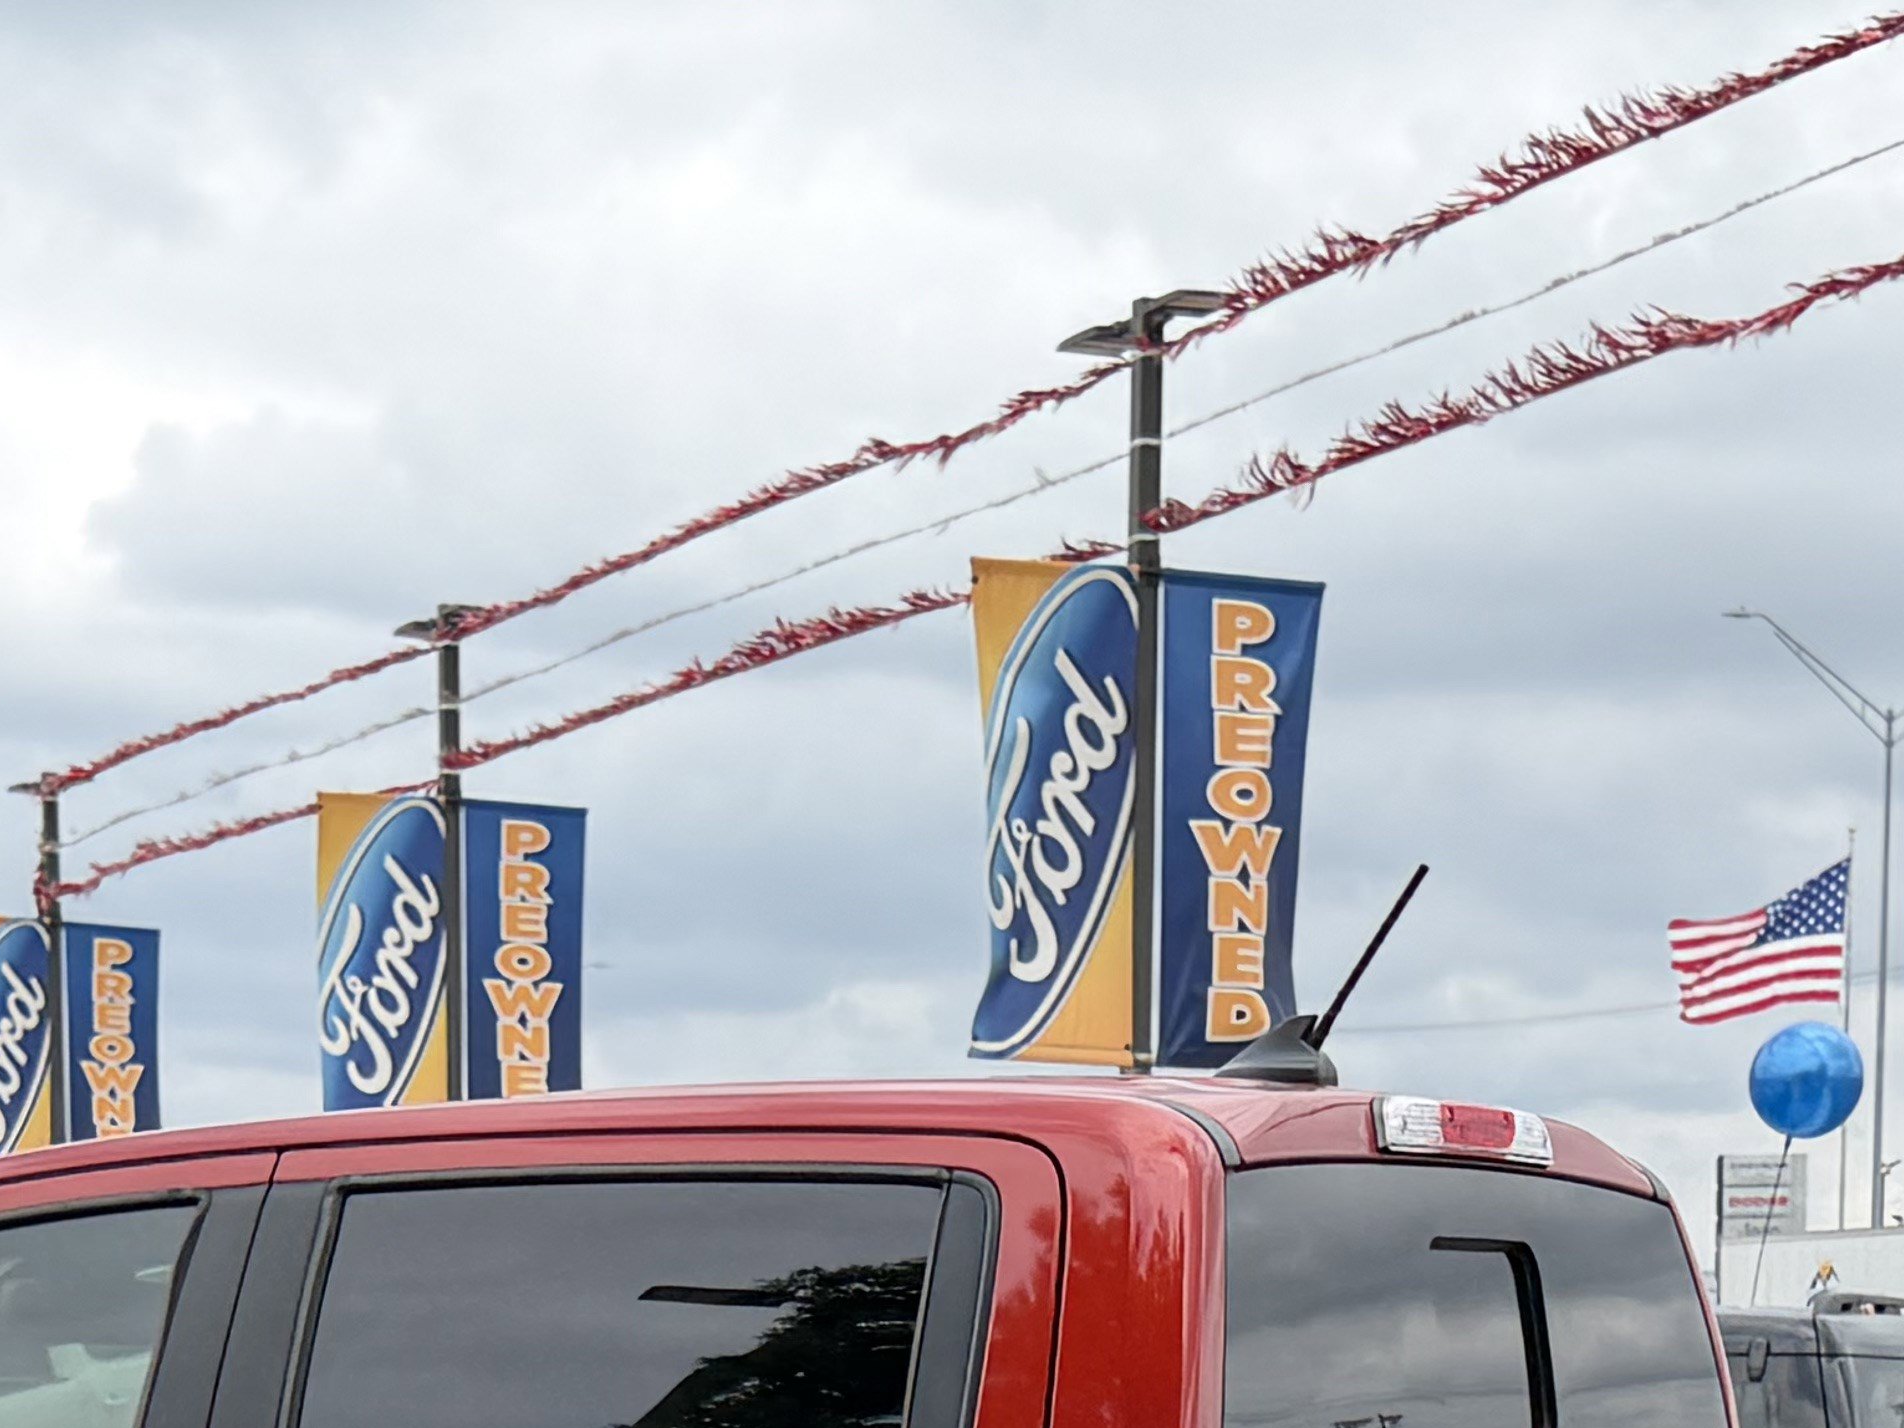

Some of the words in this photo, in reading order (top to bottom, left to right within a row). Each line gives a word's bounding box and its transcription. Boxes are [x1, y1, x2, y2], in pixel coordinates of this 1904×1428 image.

[985, 647, 1129, 983] Ford
[1189, 597, 1284, 1044] PREOWNED
[80, 937, 144, 1137] PREOWN
[319, 852, 441, 1095] Ford
[482, 819, 563, 1097] PREOWNE
